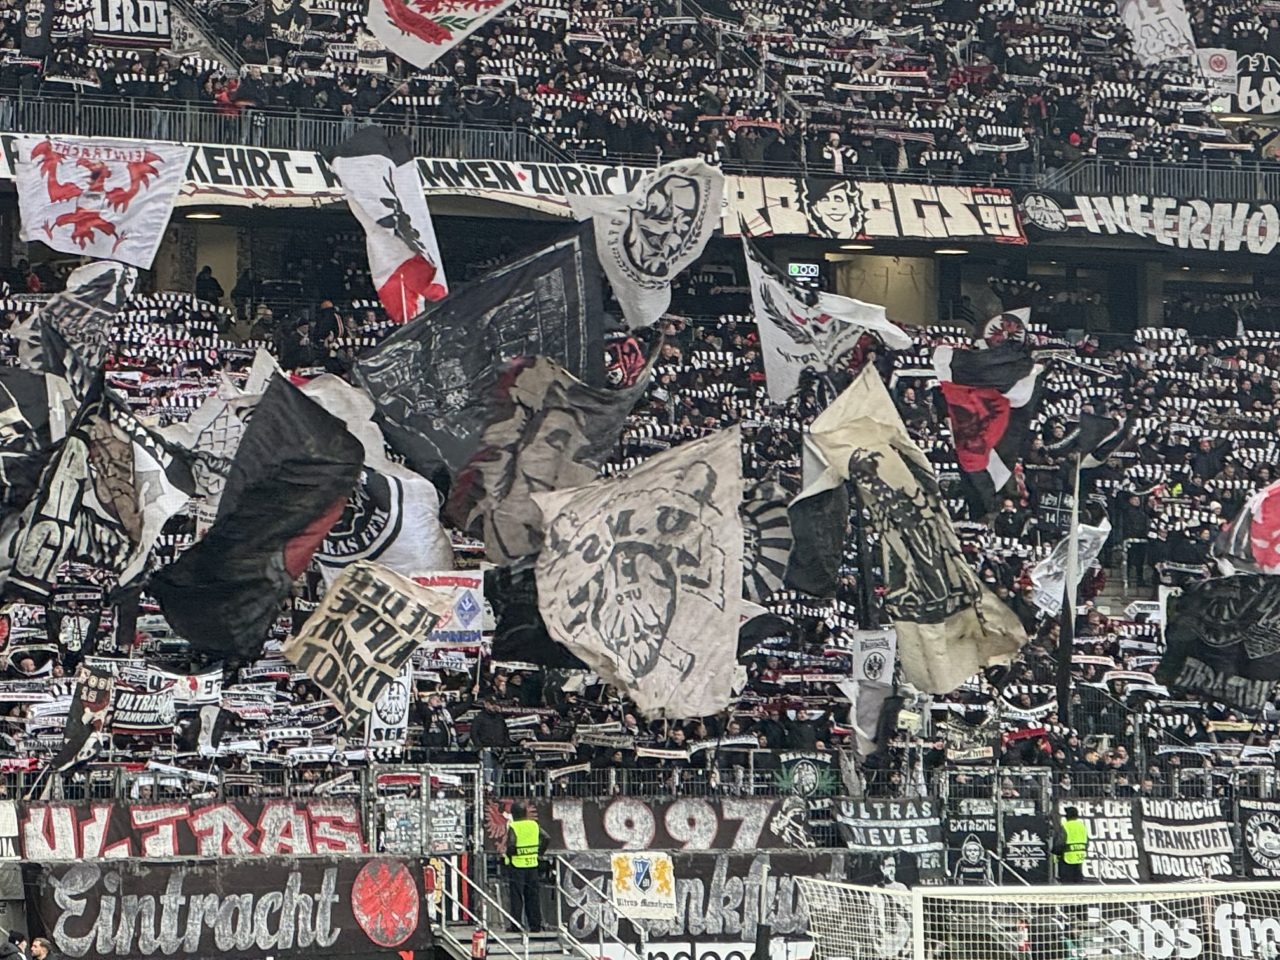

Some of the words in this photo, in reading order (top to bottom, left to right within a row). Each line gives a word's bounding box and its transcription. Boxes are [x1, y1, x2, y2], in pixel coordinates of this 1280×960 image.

[117, 693, 163, 712] ULTRAS
[114, 710, 158, 723] FRANKFURT
[840, 800, 933, 820] ULTRAS
[1059, 800, 1095, 816] ERE
[1103, 800, 1132, 817] DER
[1141, 798, 1223, 820] EINTRACHT
[21, 801, 369, 859] ULTRAS
[551, 797, 776, 851] 1997
[949, 819, 996, 831] EXTREME
[852, 826, 929, 845] NEVER
[1145, 827, 1229, 850] FRANKFURT
[1150, 855, 1234, 878] HOOLIGANS
[48, 861, 342, 958] Eintracht
